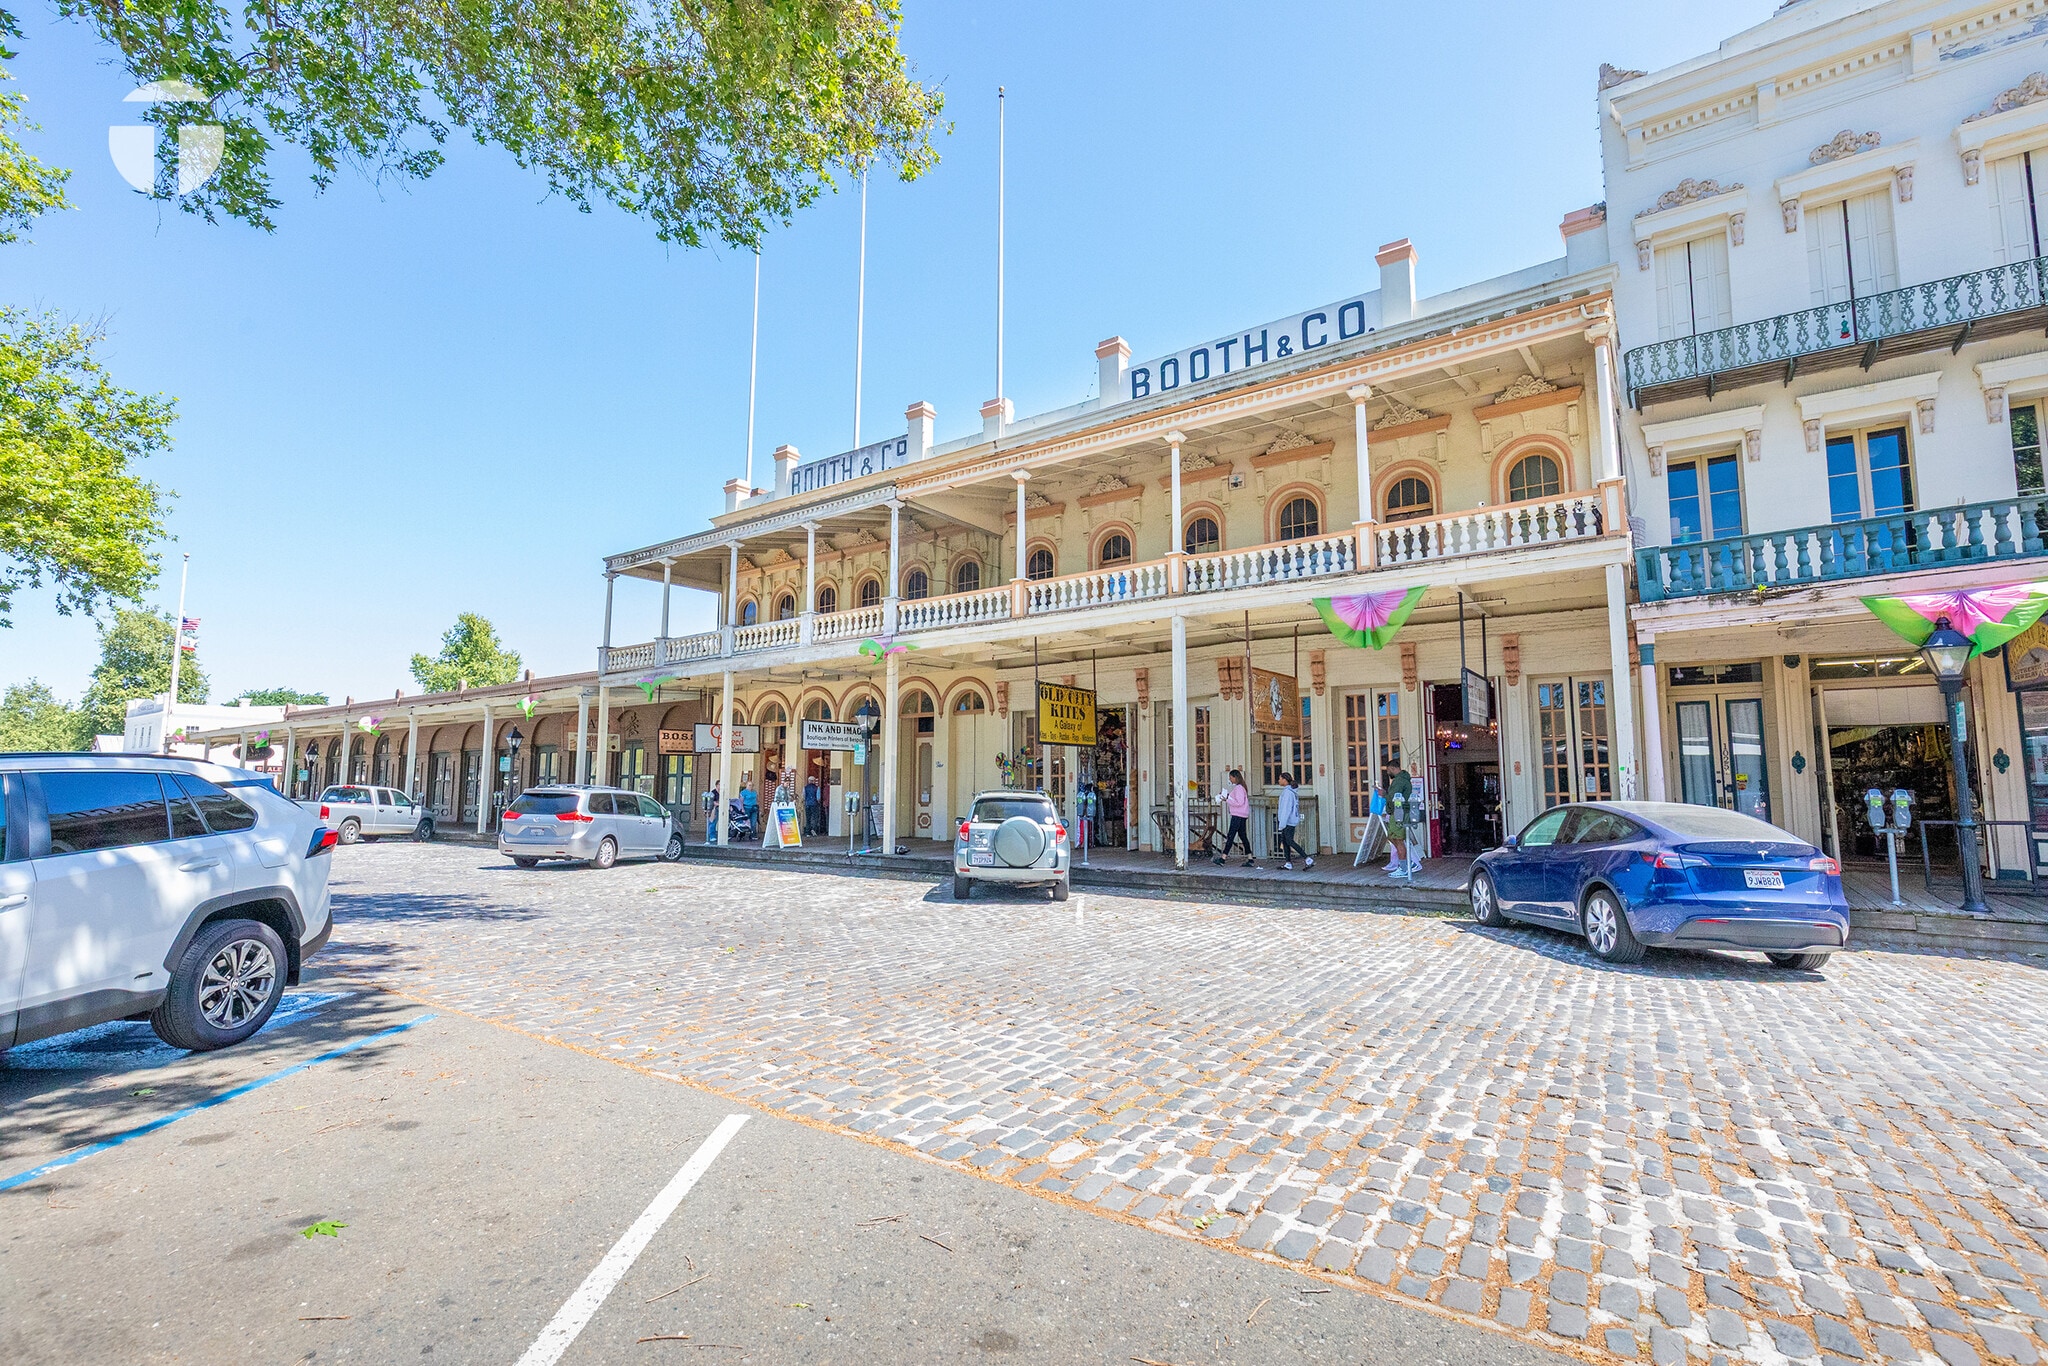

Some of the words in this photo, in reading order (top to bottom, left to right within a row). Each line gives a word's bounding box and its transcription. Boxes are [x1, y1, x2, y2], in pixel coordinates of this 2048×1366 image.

[1131, 329, 1269, 401] BOOTH
[1301, 300, 1376, 351] CO.
[791, 455, 853, 496] BOOTH
[1040, 686, 1064, 702] OLD
[1068, 690, 1093, 707] CITY
[1051, 704, 1086, 721] KITES
[808, 724, 824, 733] INK
[825, 725, 842, 734] AND
